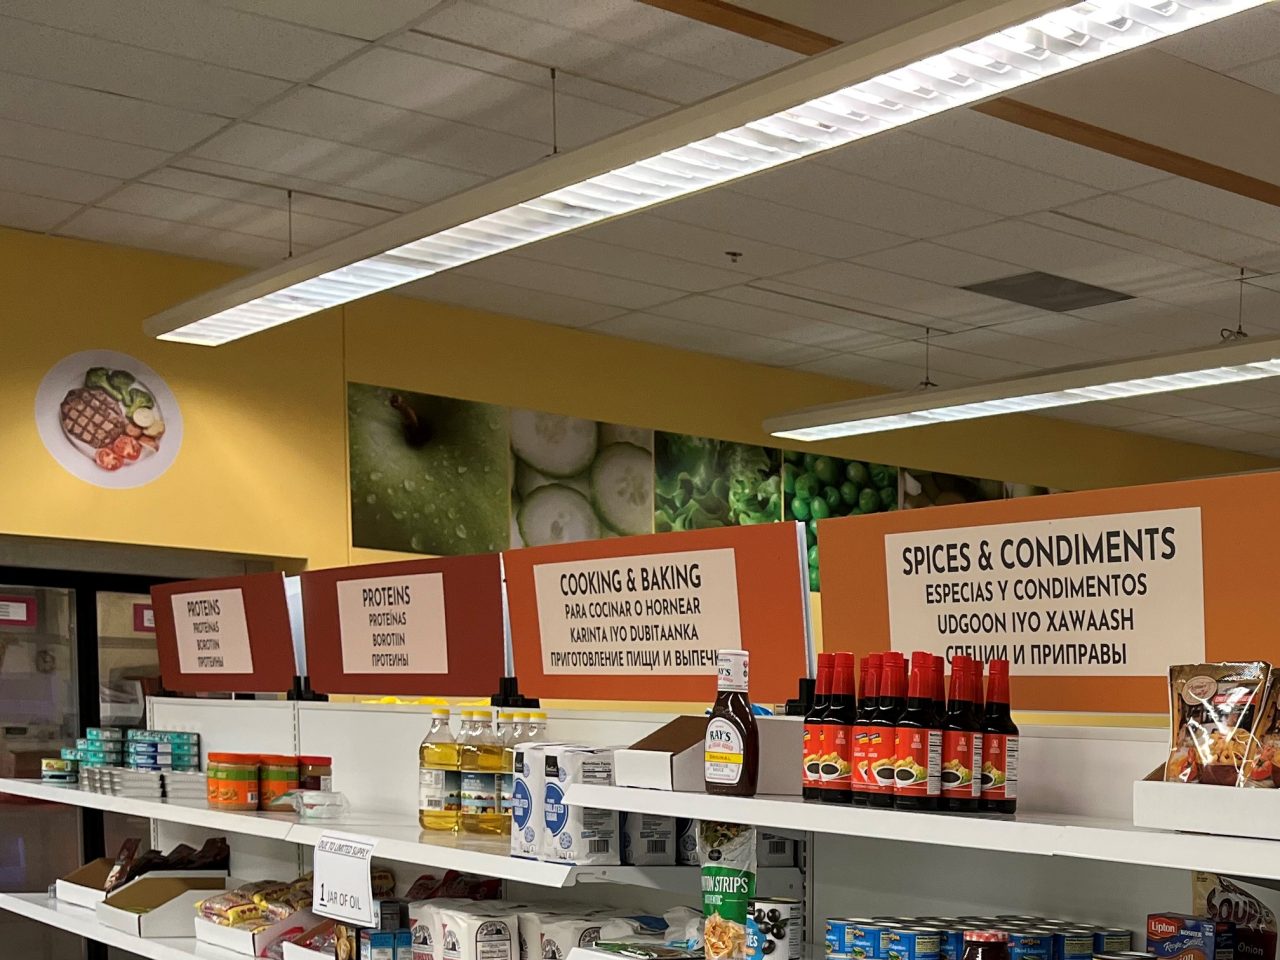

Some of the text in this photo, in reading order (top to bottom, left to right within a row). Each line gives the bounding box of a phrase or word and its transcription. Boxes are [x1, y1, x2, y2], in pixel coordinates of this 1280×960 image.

[902, 526, 1176, 576] SPICES & CONDIMENTS
[560, 563, 701, 596] COOKING & BAKING
[926, 573, 1147, 604] ESPECIAS Y CONDIMENTOS
[362, 585, 411, 607] PROTEINS
[187, 599, 221, 617] PROTEINS
[565, 597, 701, 619] PARA COCINAR O HORNEAR
[369, 610, 407, 627] PROTEÍNAS
[937, 608, 1134, 634] UDGOON IYO XAWAASH
[372, 632, 406, 647] BOROTIIN
[570, 623, 699, 643] KARINTA IYO DUBITAANKA
[372, 653, 408, 667] ПРОТЕИНЫ
[550, 650, 624, 667] ПРИГОТОВЛЕНИЕ
[626, 650, 661, 670] ПИЩИ
[663, 650, 672, 666] И
[1013, 645, 1025, 664] И
[1030, 643, 1127, 664] ПРИПРАВЫ
[709, 730, 732, 742] RAY'S
[715, 876, 748, 894] STRIPS
[320, 883, 362, 910] 1 JAR OF OIL
[1151, 921, 1176, 933] Lipton
[1237, 942, 1264, 956] Onion
